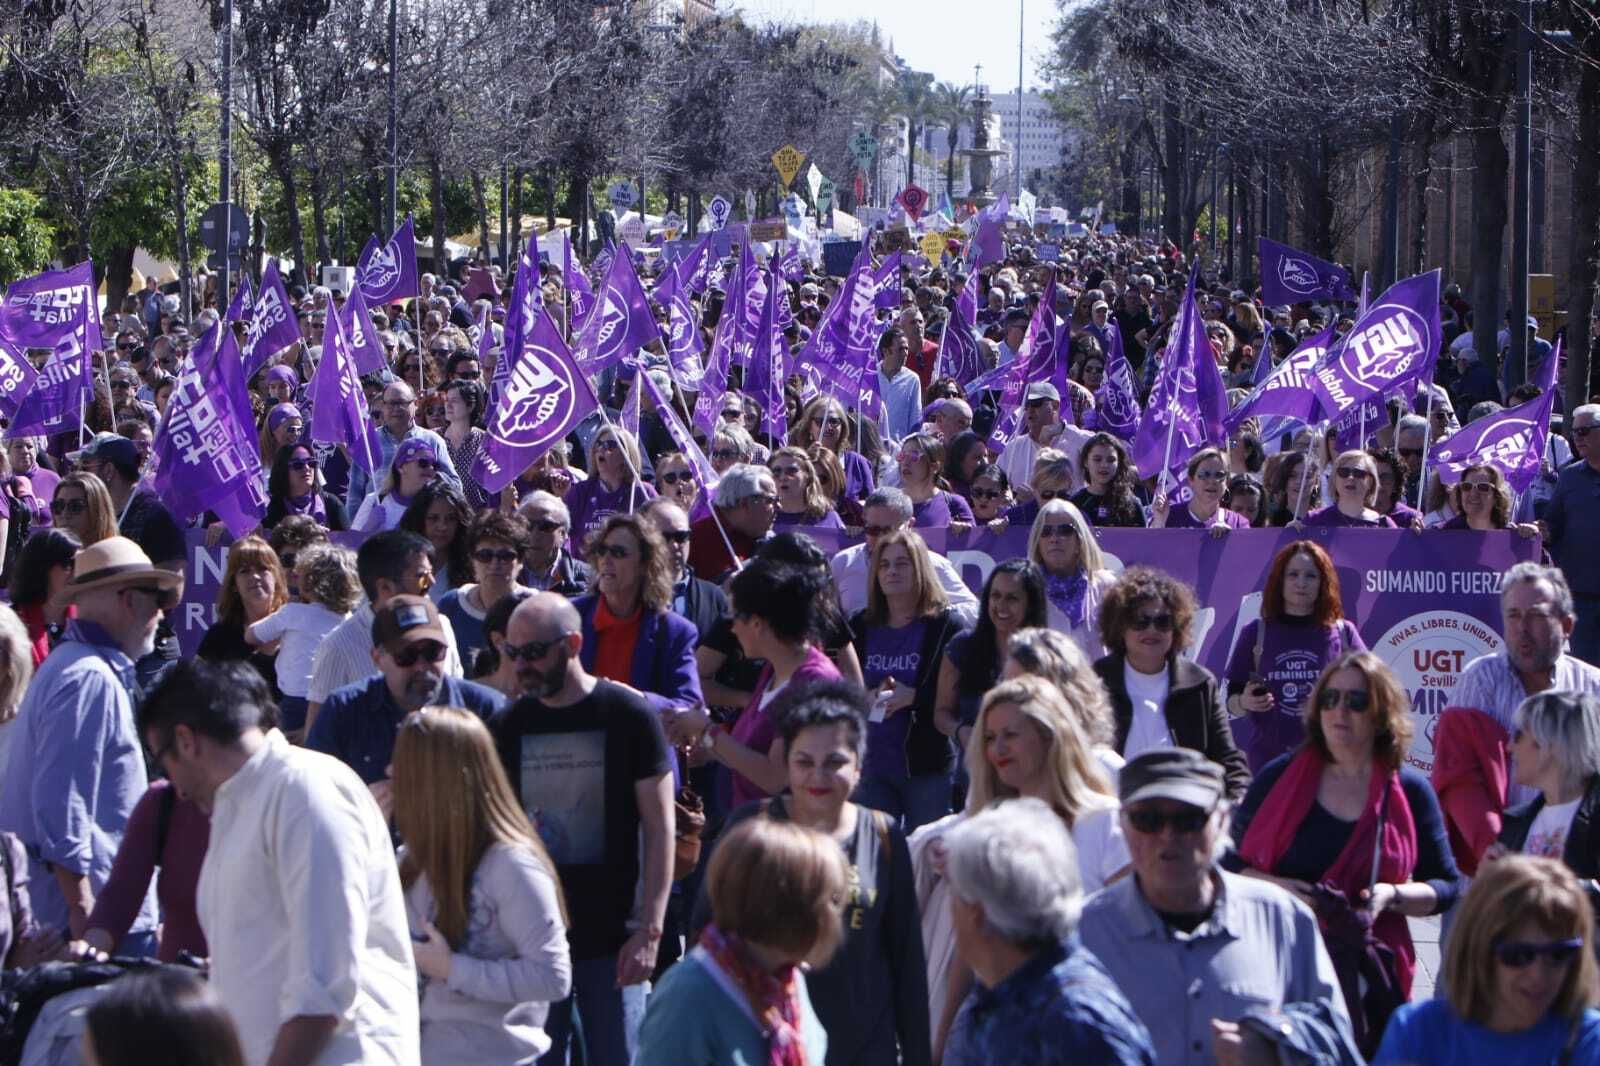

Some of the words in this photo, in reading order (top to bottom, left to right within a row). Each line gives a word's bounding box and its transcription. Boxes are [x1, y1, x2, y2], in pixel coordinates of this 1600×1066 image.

[1366, 570, 1446, 593] SUMANDO
[1451, 572, 1502, 594] FUERZ
[1463, 622, 1498, 649] UNIDAS
[1286, 660, 1308, 670] UGT
[1413, 649, 1465, 673] UGT
[1267, 670, 1320, 681] FEMINIST
